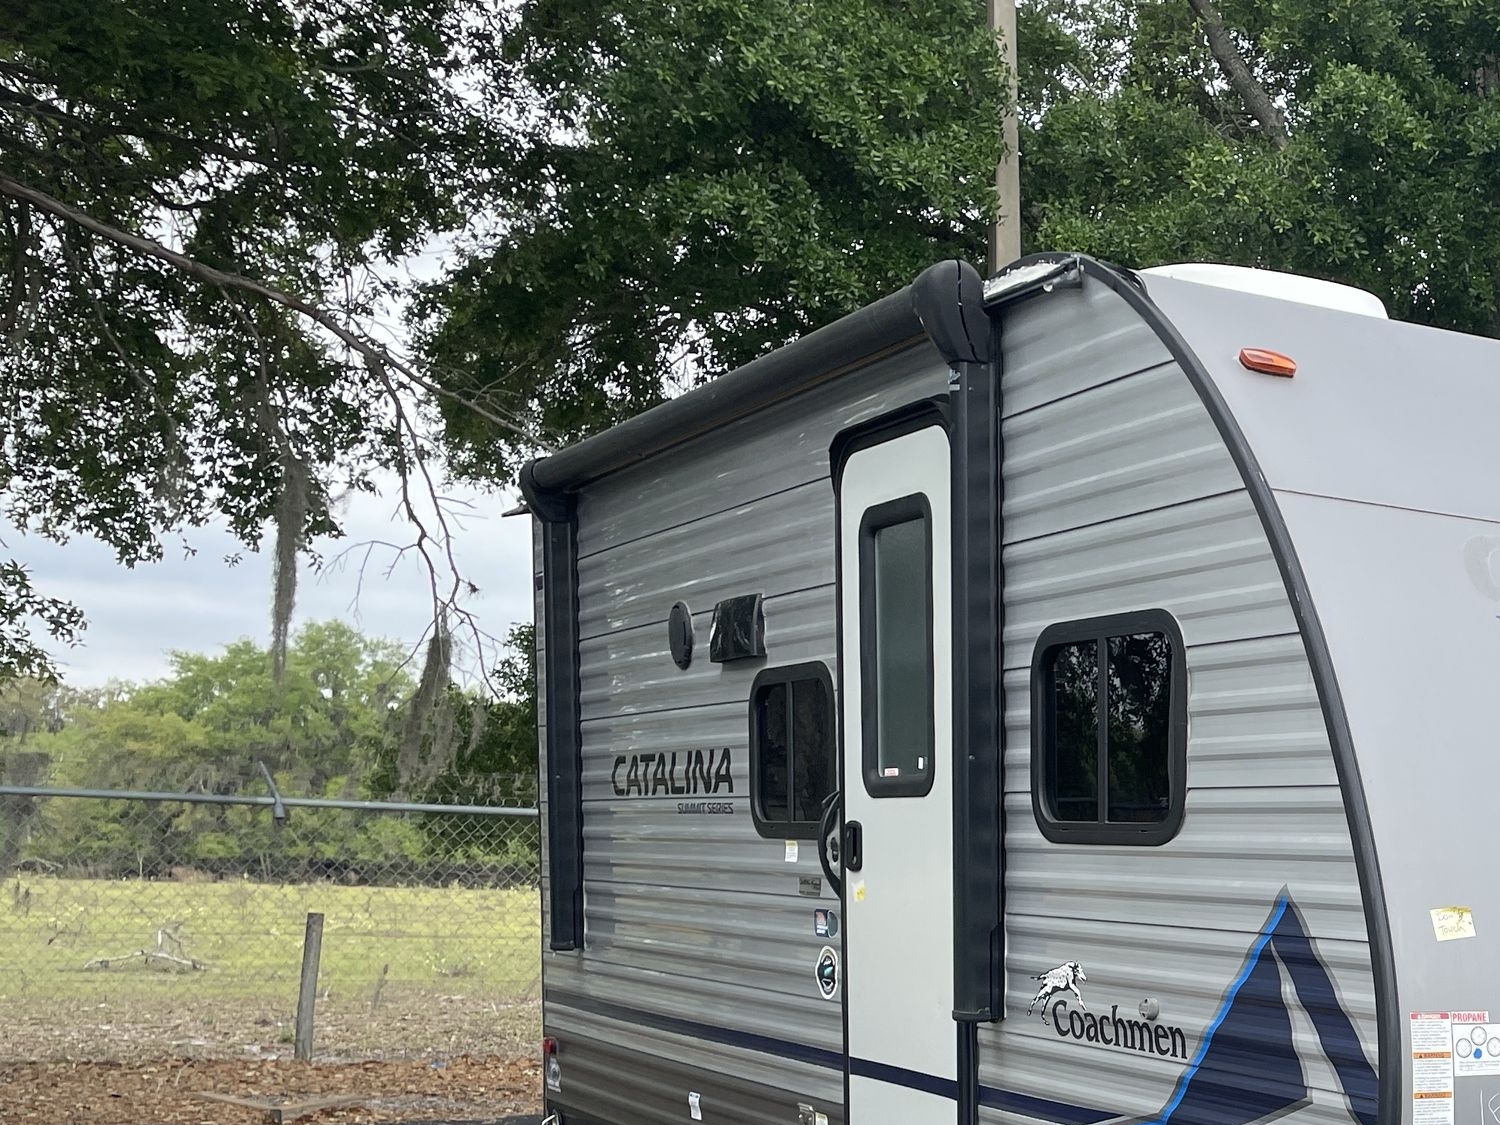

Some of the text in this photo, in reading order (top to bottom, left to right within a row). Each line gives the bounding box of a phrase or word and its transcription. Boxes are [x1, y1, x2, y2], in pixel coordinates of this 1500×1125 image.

[611, 747, 734, 797] CATALINA
[677, 802, 734, 815] SUMMIT SERIES
[1052, 999, 1188, 1060] Coachmen
[1452, 1012, 1487, 1022] PROPANE
